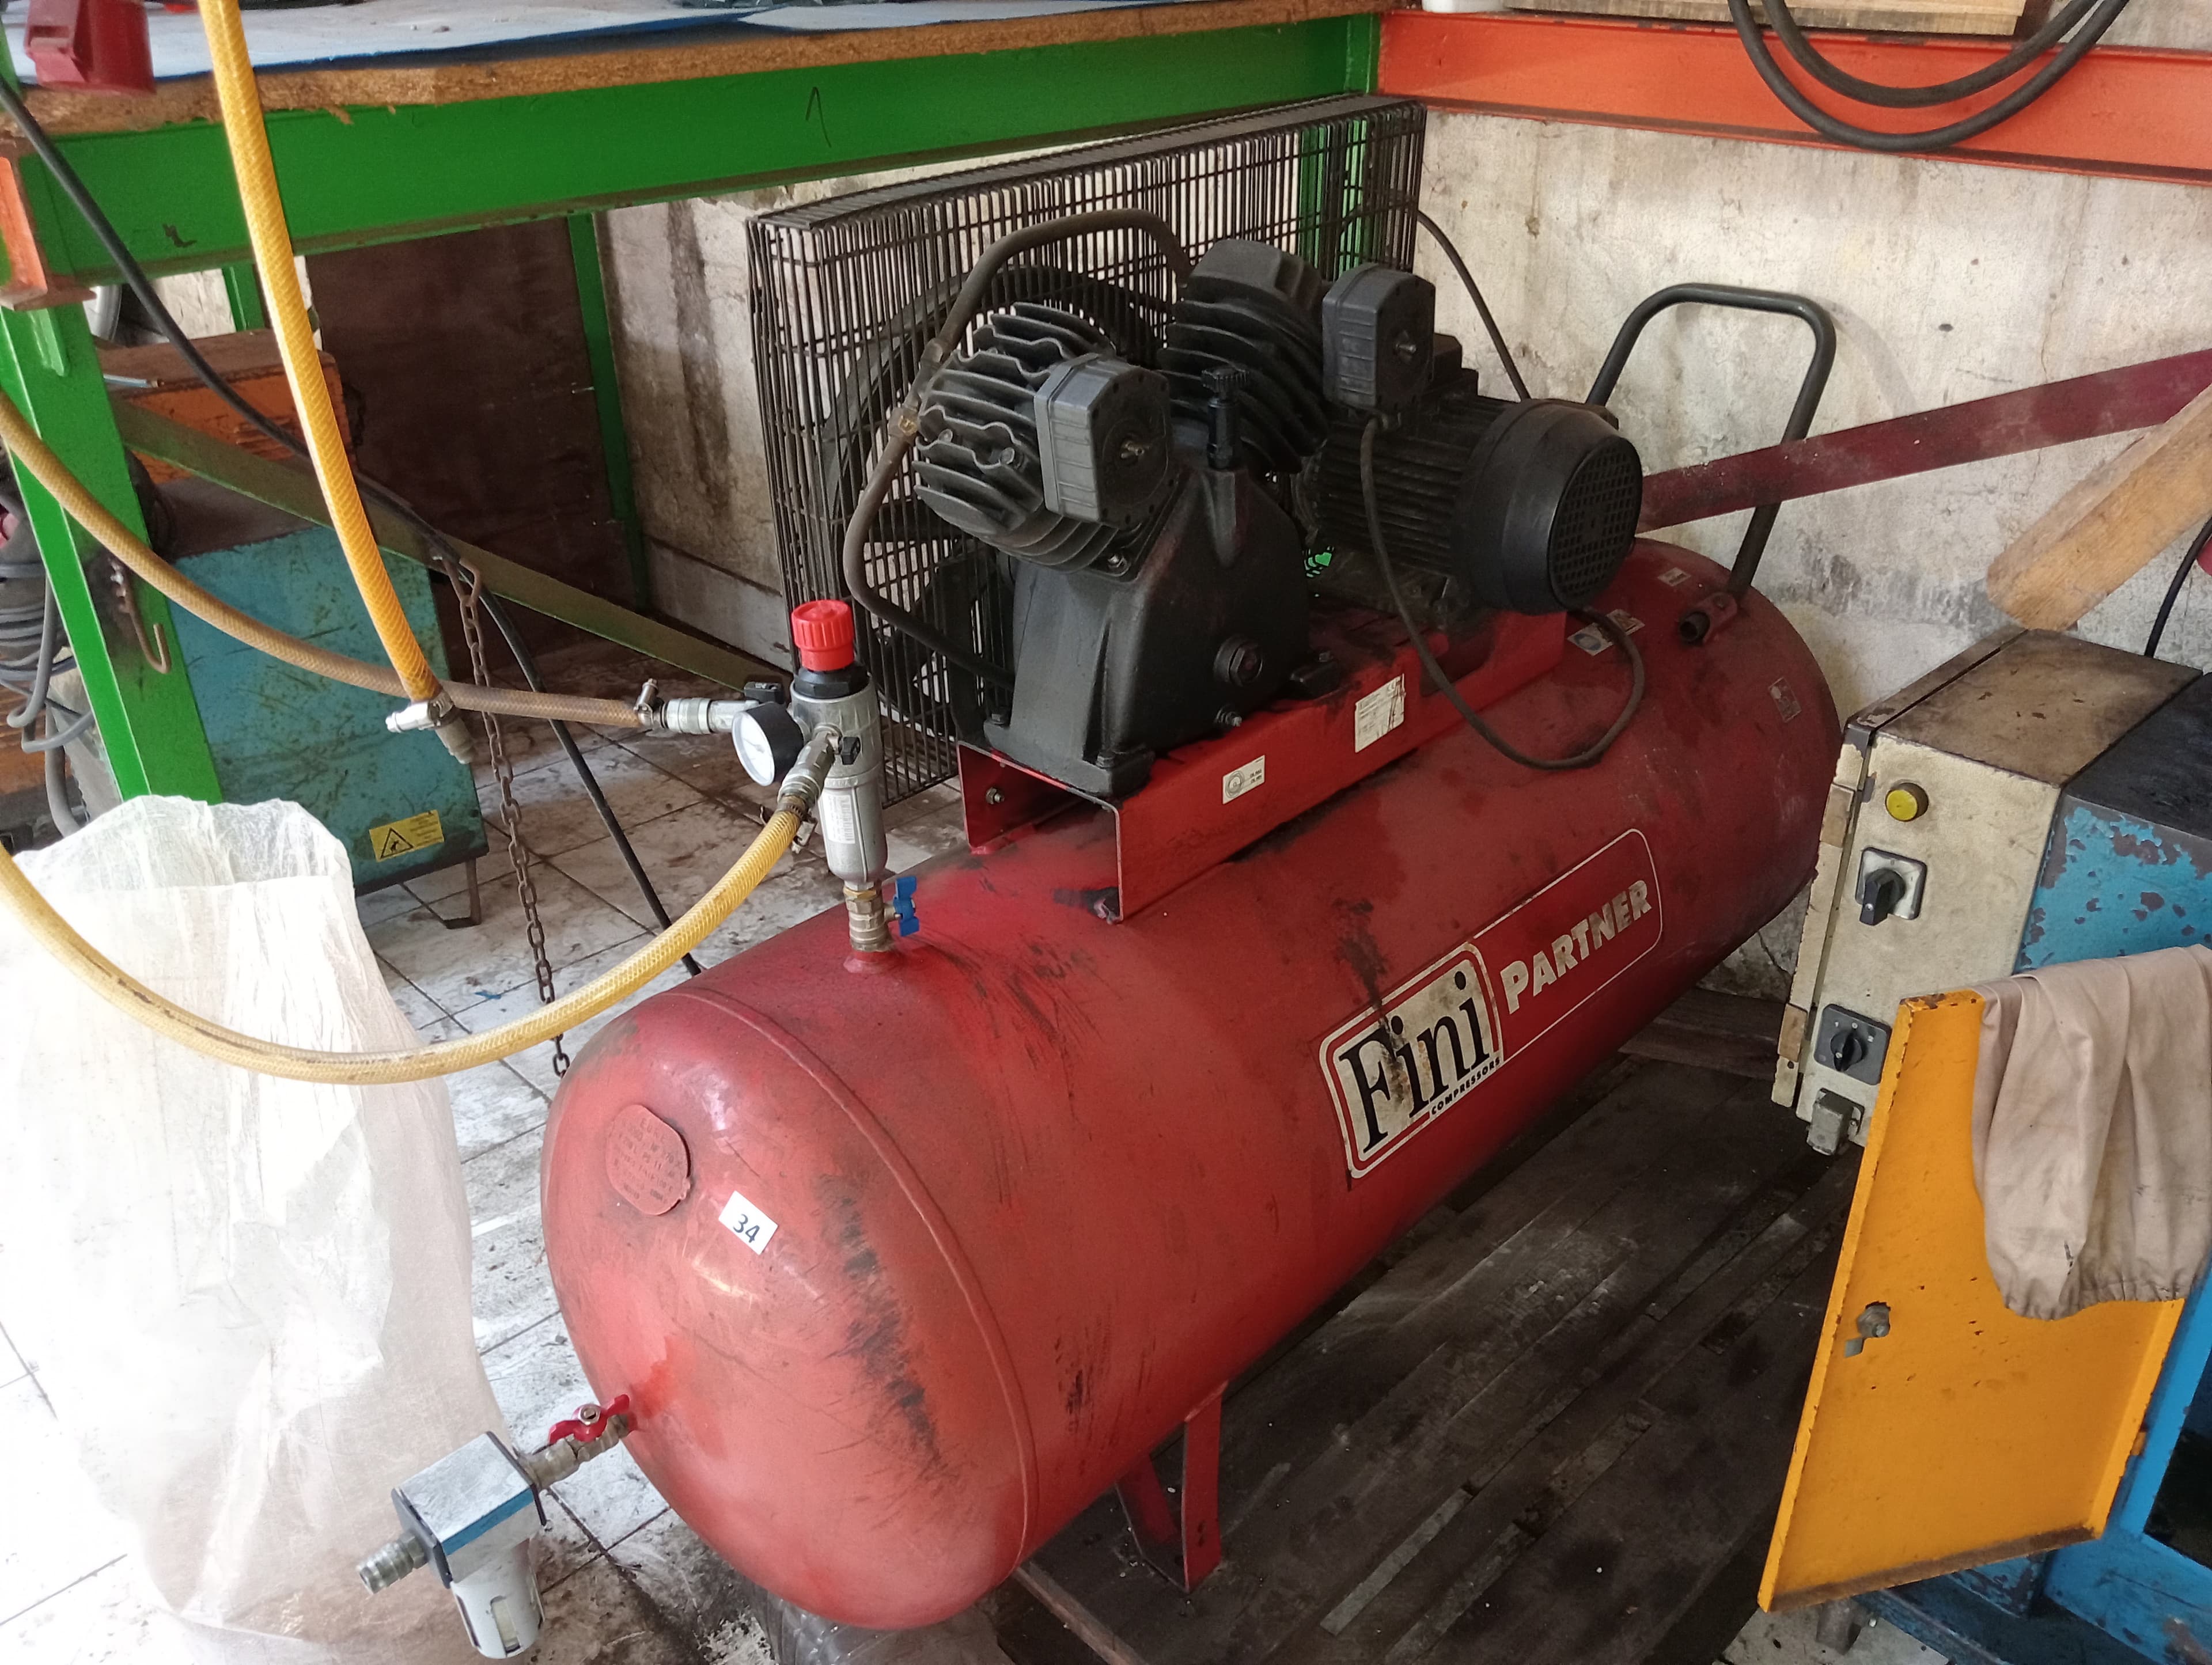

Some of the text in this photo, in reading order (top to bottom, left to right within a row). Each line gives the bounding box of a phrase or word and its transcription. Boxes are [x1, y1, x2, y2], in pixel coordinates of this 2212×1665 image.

[1500, 880, 1653, 1015] PARTNER
[1339, 970, 1490, 1154] Fini
[1431, 1056, 1500, 1115] COMPRESSORS
[733, 1213, 760, 1243] 34
